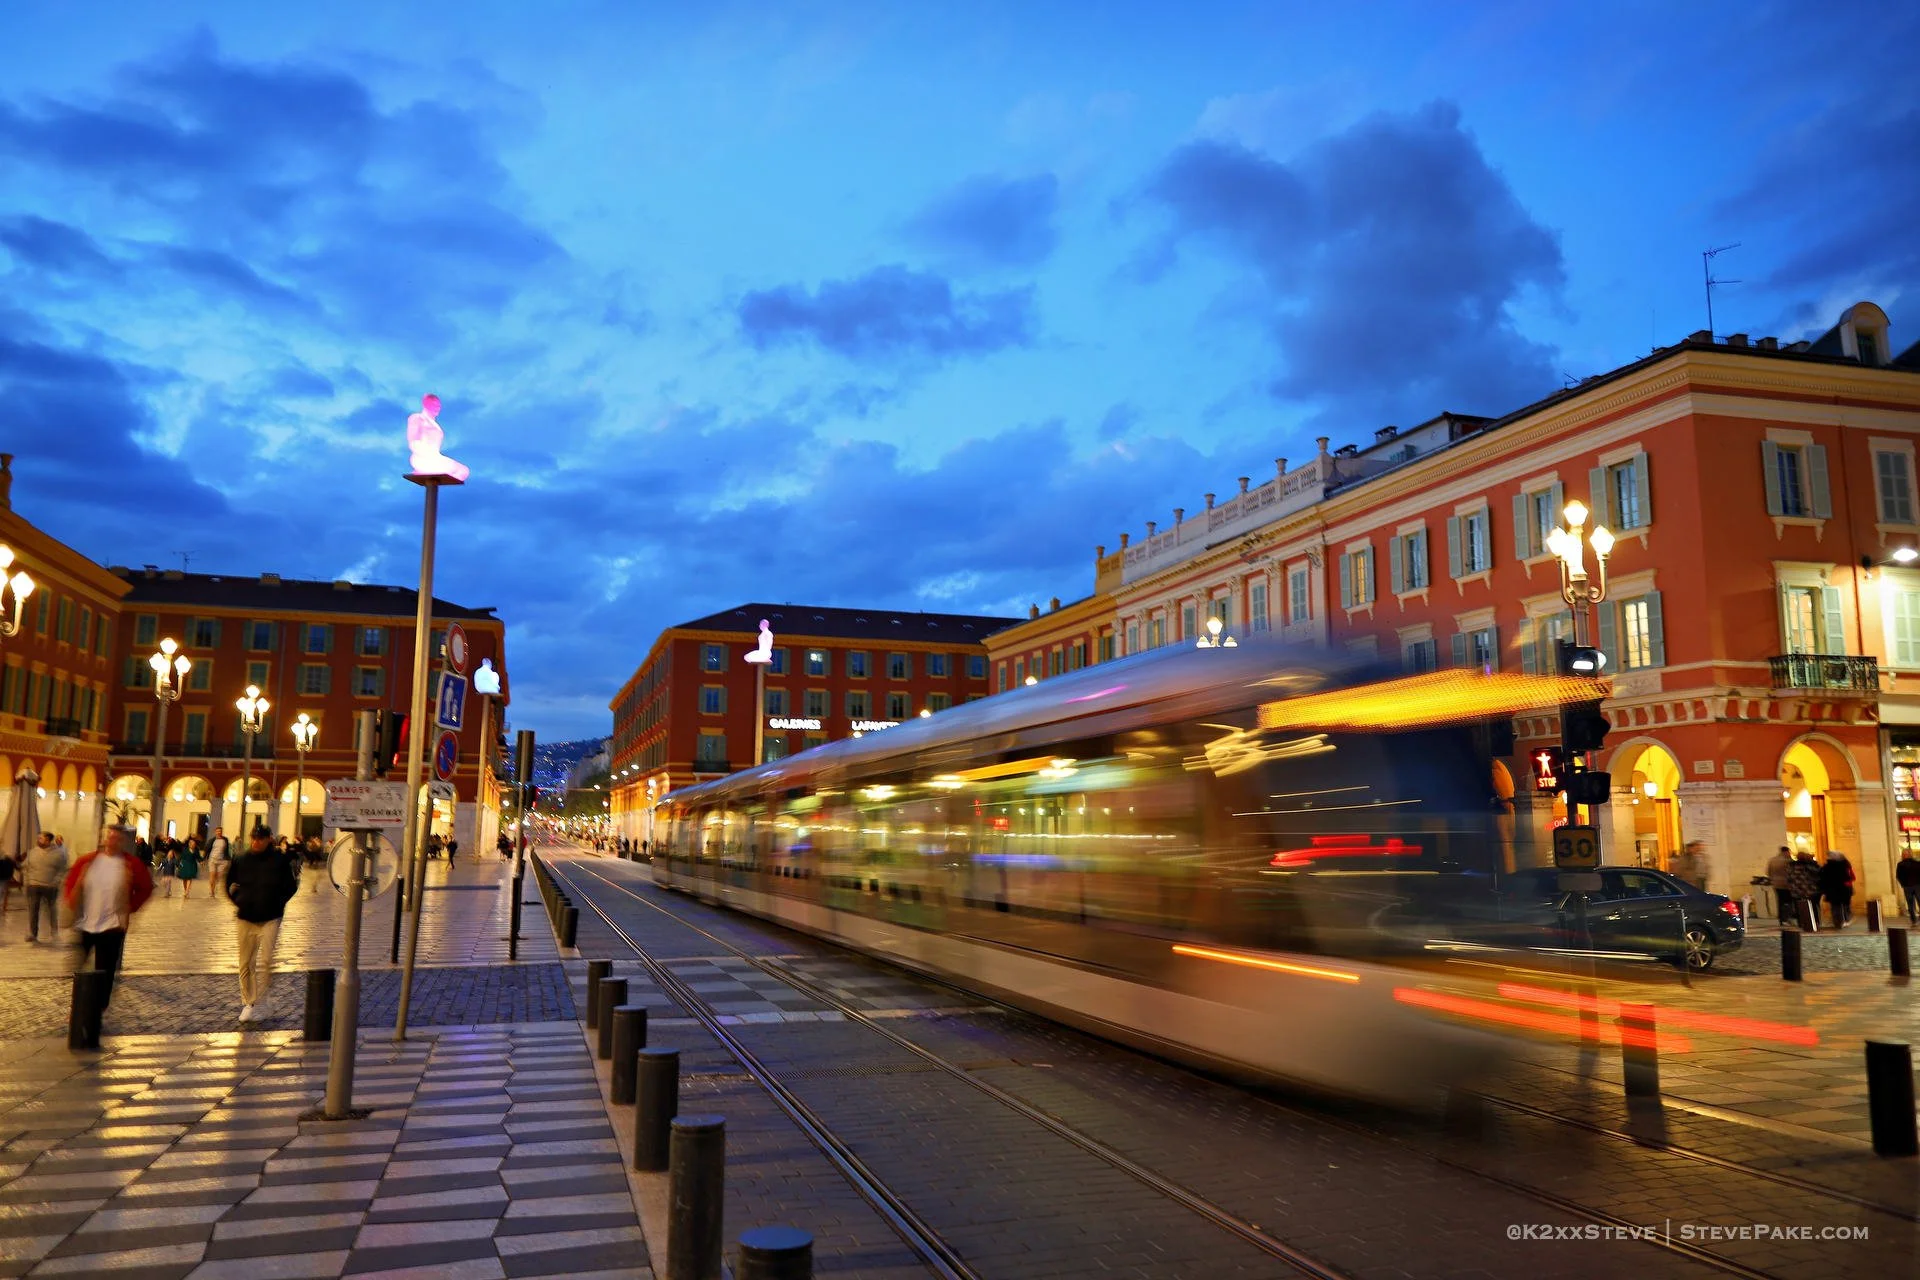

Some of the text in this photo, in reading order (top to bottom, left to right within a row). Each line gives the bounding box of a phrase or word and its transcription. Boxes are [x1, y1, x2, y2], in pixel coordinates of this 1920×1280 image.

[769, 718, 821, 730] GALERIES
[1538, 777, 1556, 787] STOP
[330, 785, 371, 794] DANGER
[359, 808, 404, 816] TRAMWAY
[1558, 838, 1593, 858] 30
